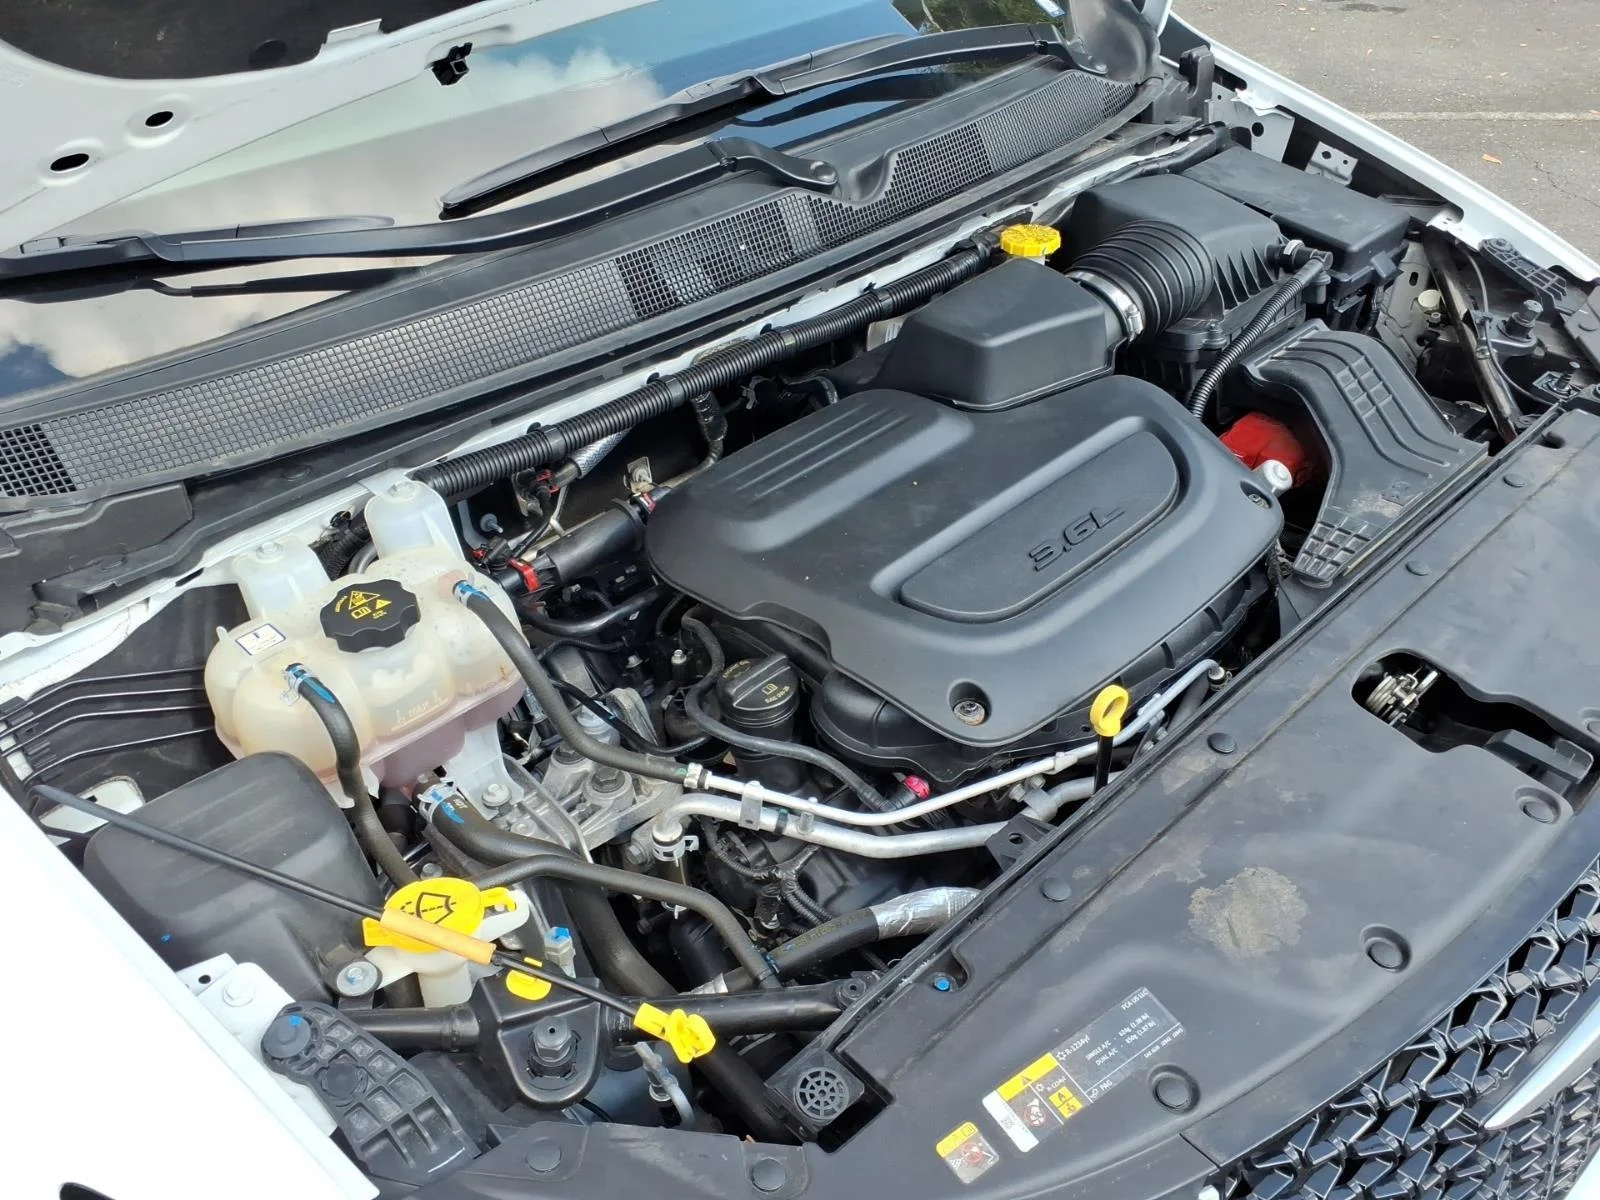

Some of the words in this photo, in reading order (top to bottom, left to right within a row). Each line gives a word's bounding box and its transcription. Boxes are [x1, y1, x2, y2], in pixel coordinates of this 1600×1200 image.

[1028, 507, 1125, 572] 3.6L
[1064, 1034, 1090, 1055] R-1234yf
[1095, 1054, 1109, 1065] DUAL
[1108, 1047, 1118, 1056] A/C
[1099, 1079, 1113, 1091] PAG
